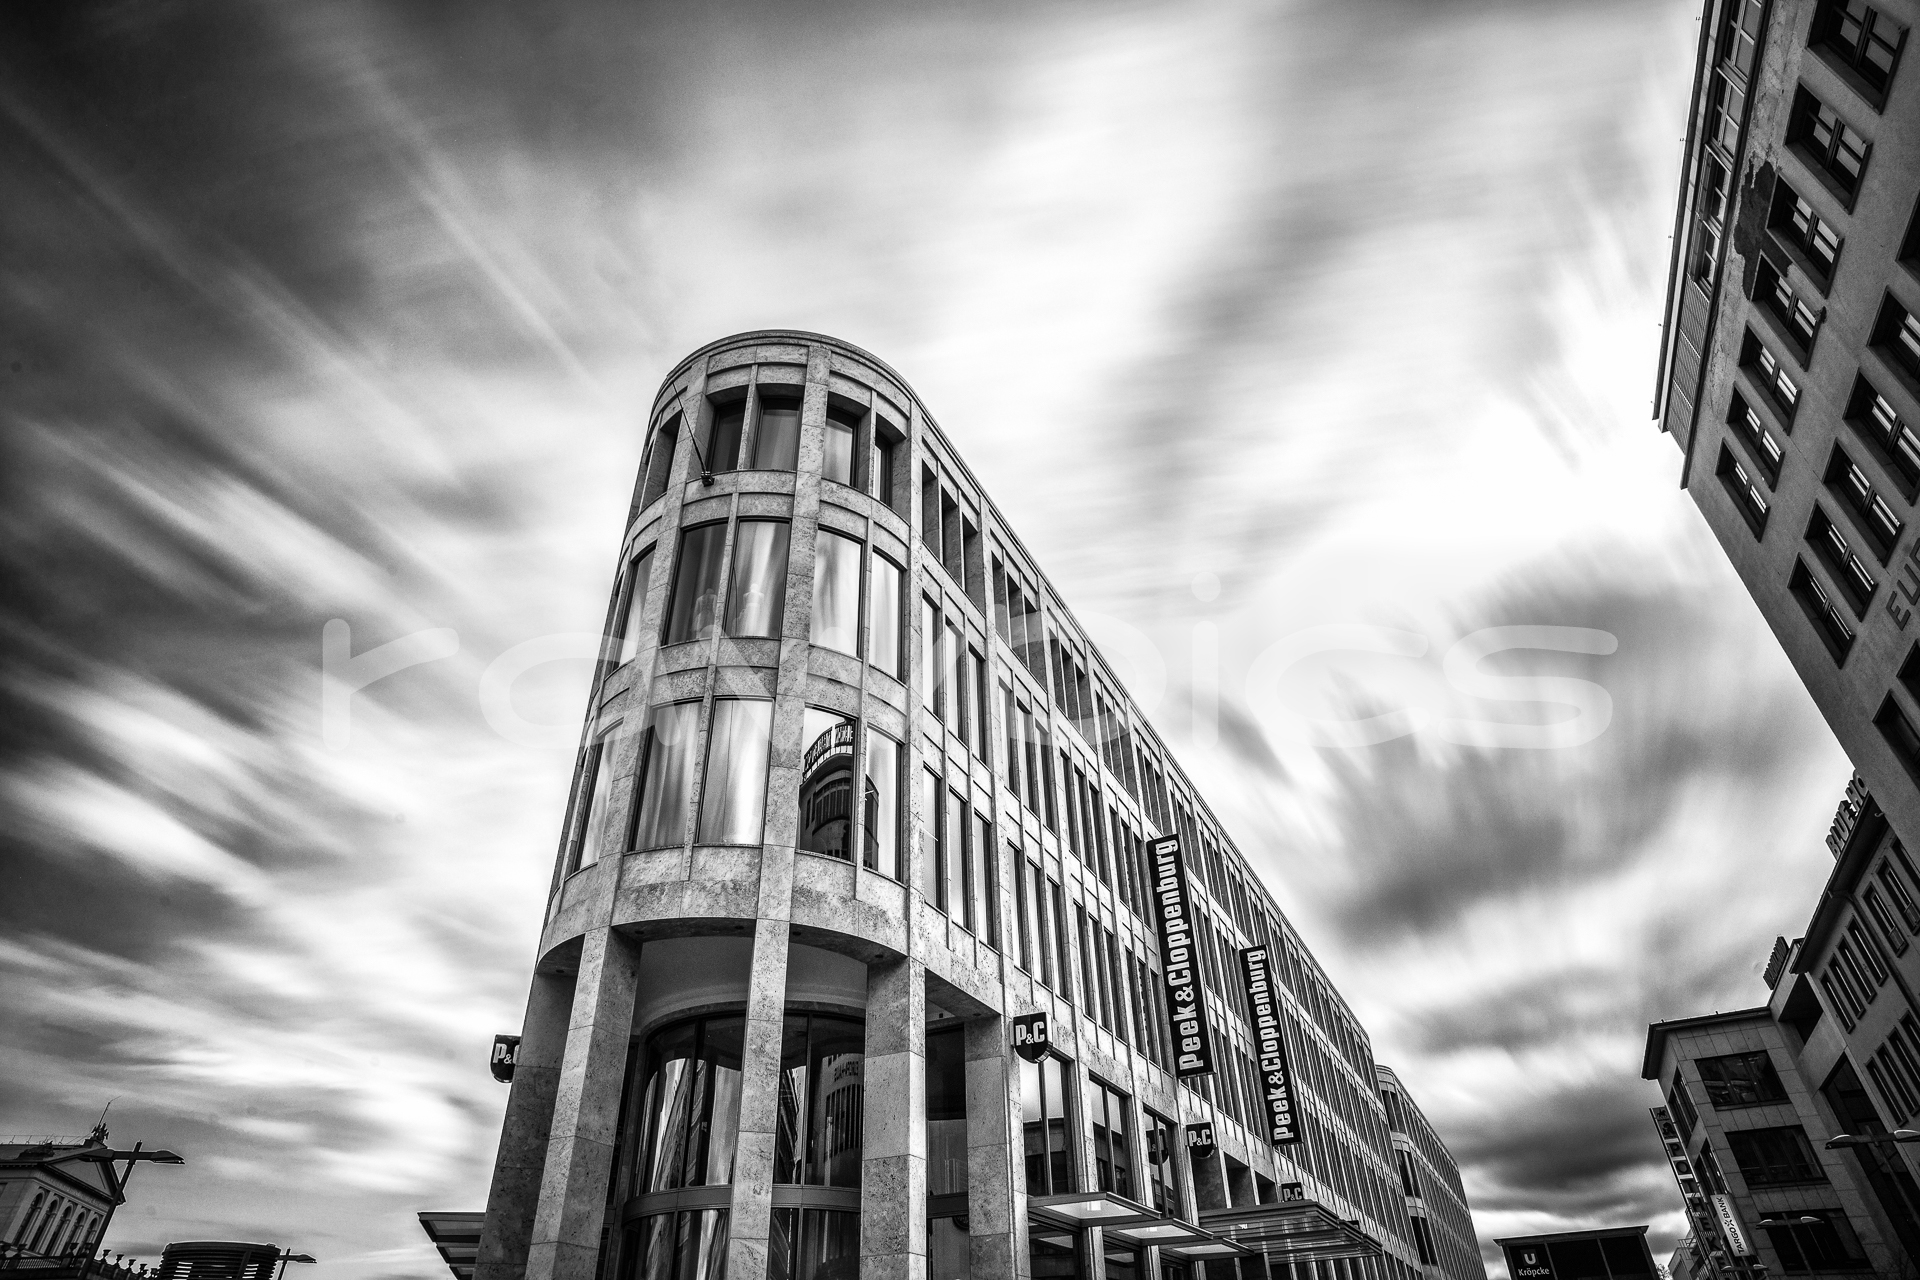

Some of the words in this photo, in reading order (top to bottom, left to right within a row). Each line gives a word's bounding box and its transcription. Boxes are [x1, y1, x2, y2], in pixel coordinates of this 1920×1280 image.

[1015, 1021, 1046, 1046] P&C
[1188, 1129, 1212, 1147] P&C
[1523, 1253, 1536, 1265] U
[1517, 1266, 1550, 1278] Kröpcke
